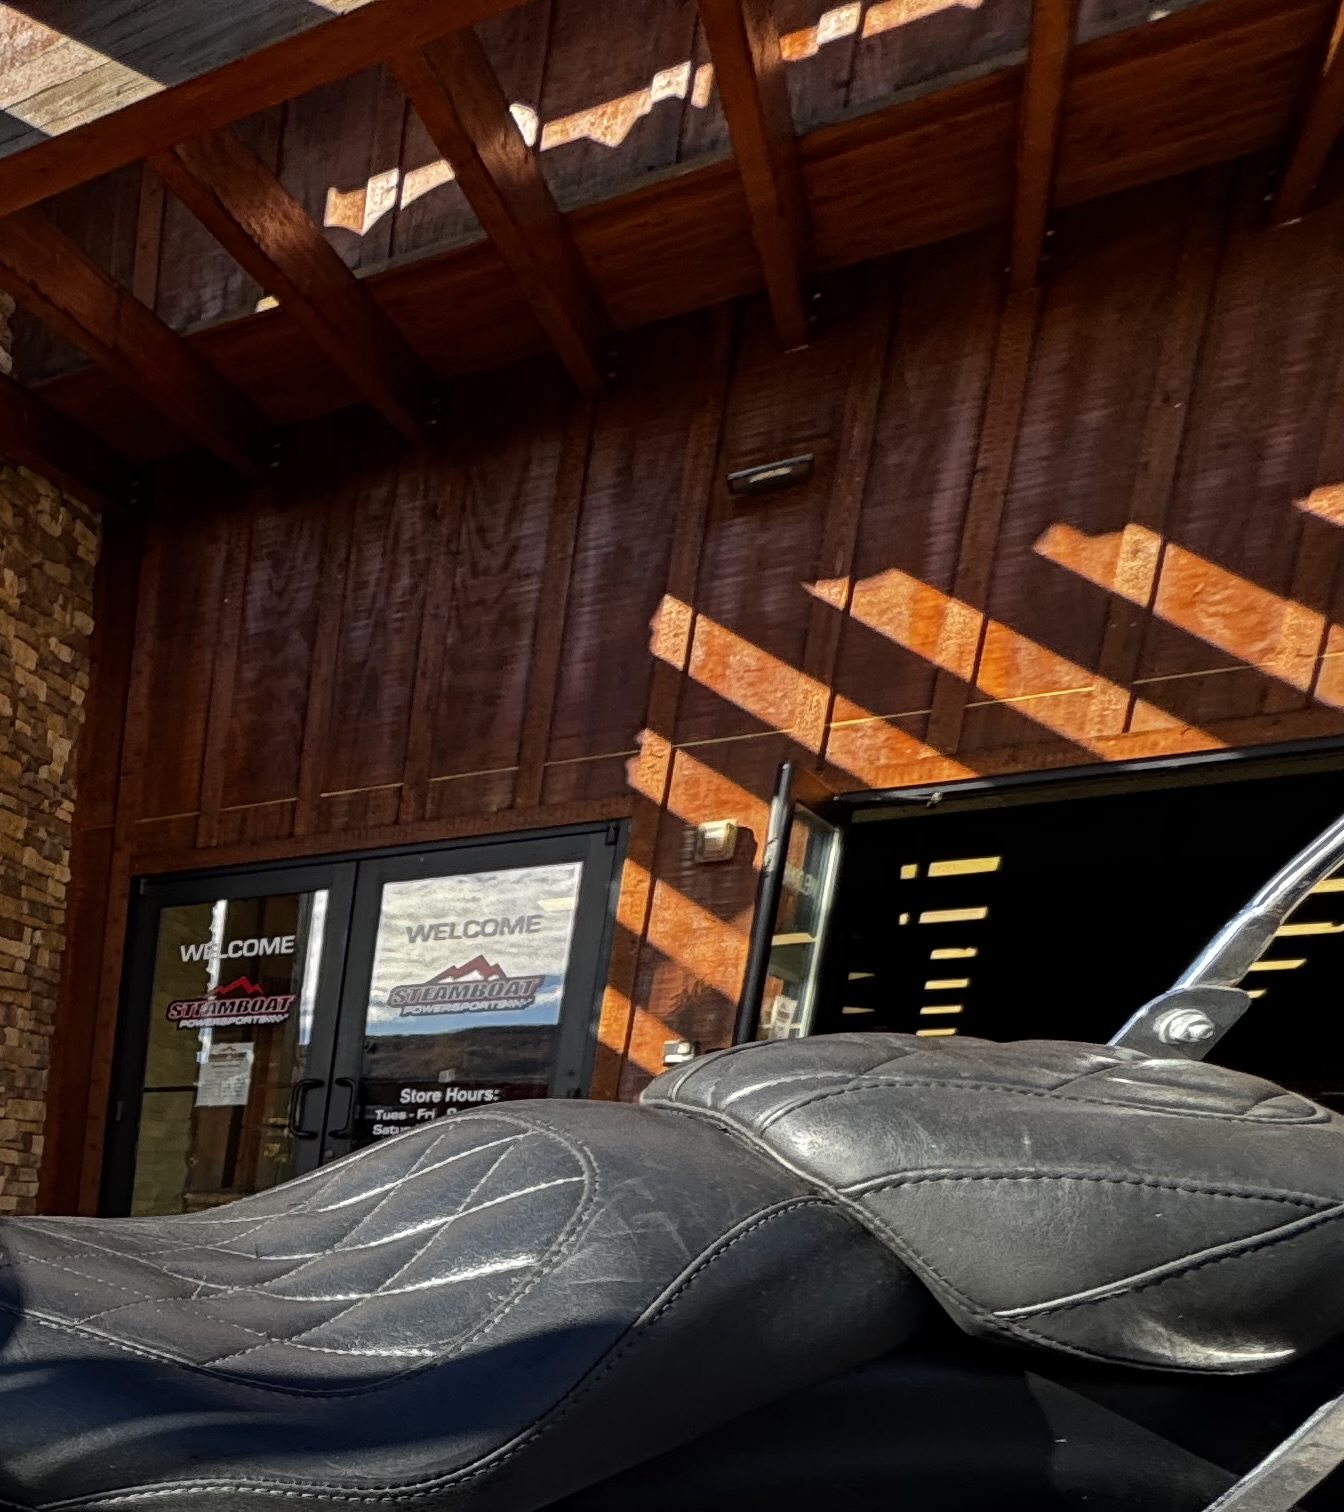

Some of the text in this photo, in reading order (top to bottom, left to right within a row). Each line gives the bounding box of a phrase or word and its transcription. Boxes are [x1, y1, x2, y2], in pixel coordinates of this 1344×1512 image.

[405, 913, 544, 944] WELCOME
[180, 935, 296, 962] WELCOME
[390, 978, 539, 1006] STEAMBOAT
[168, 995, 296, 1019] STEAMBOAT
[403, 1001, 504, 1015] POWERSPORTS
[178, 1015, 266, 1029] POWERSPORTS
[399, 1087, 500, 1104] Store Hours:
[375, 1109, 407, 1121] Tues
[416, 1108, 436, 1120] Fri
